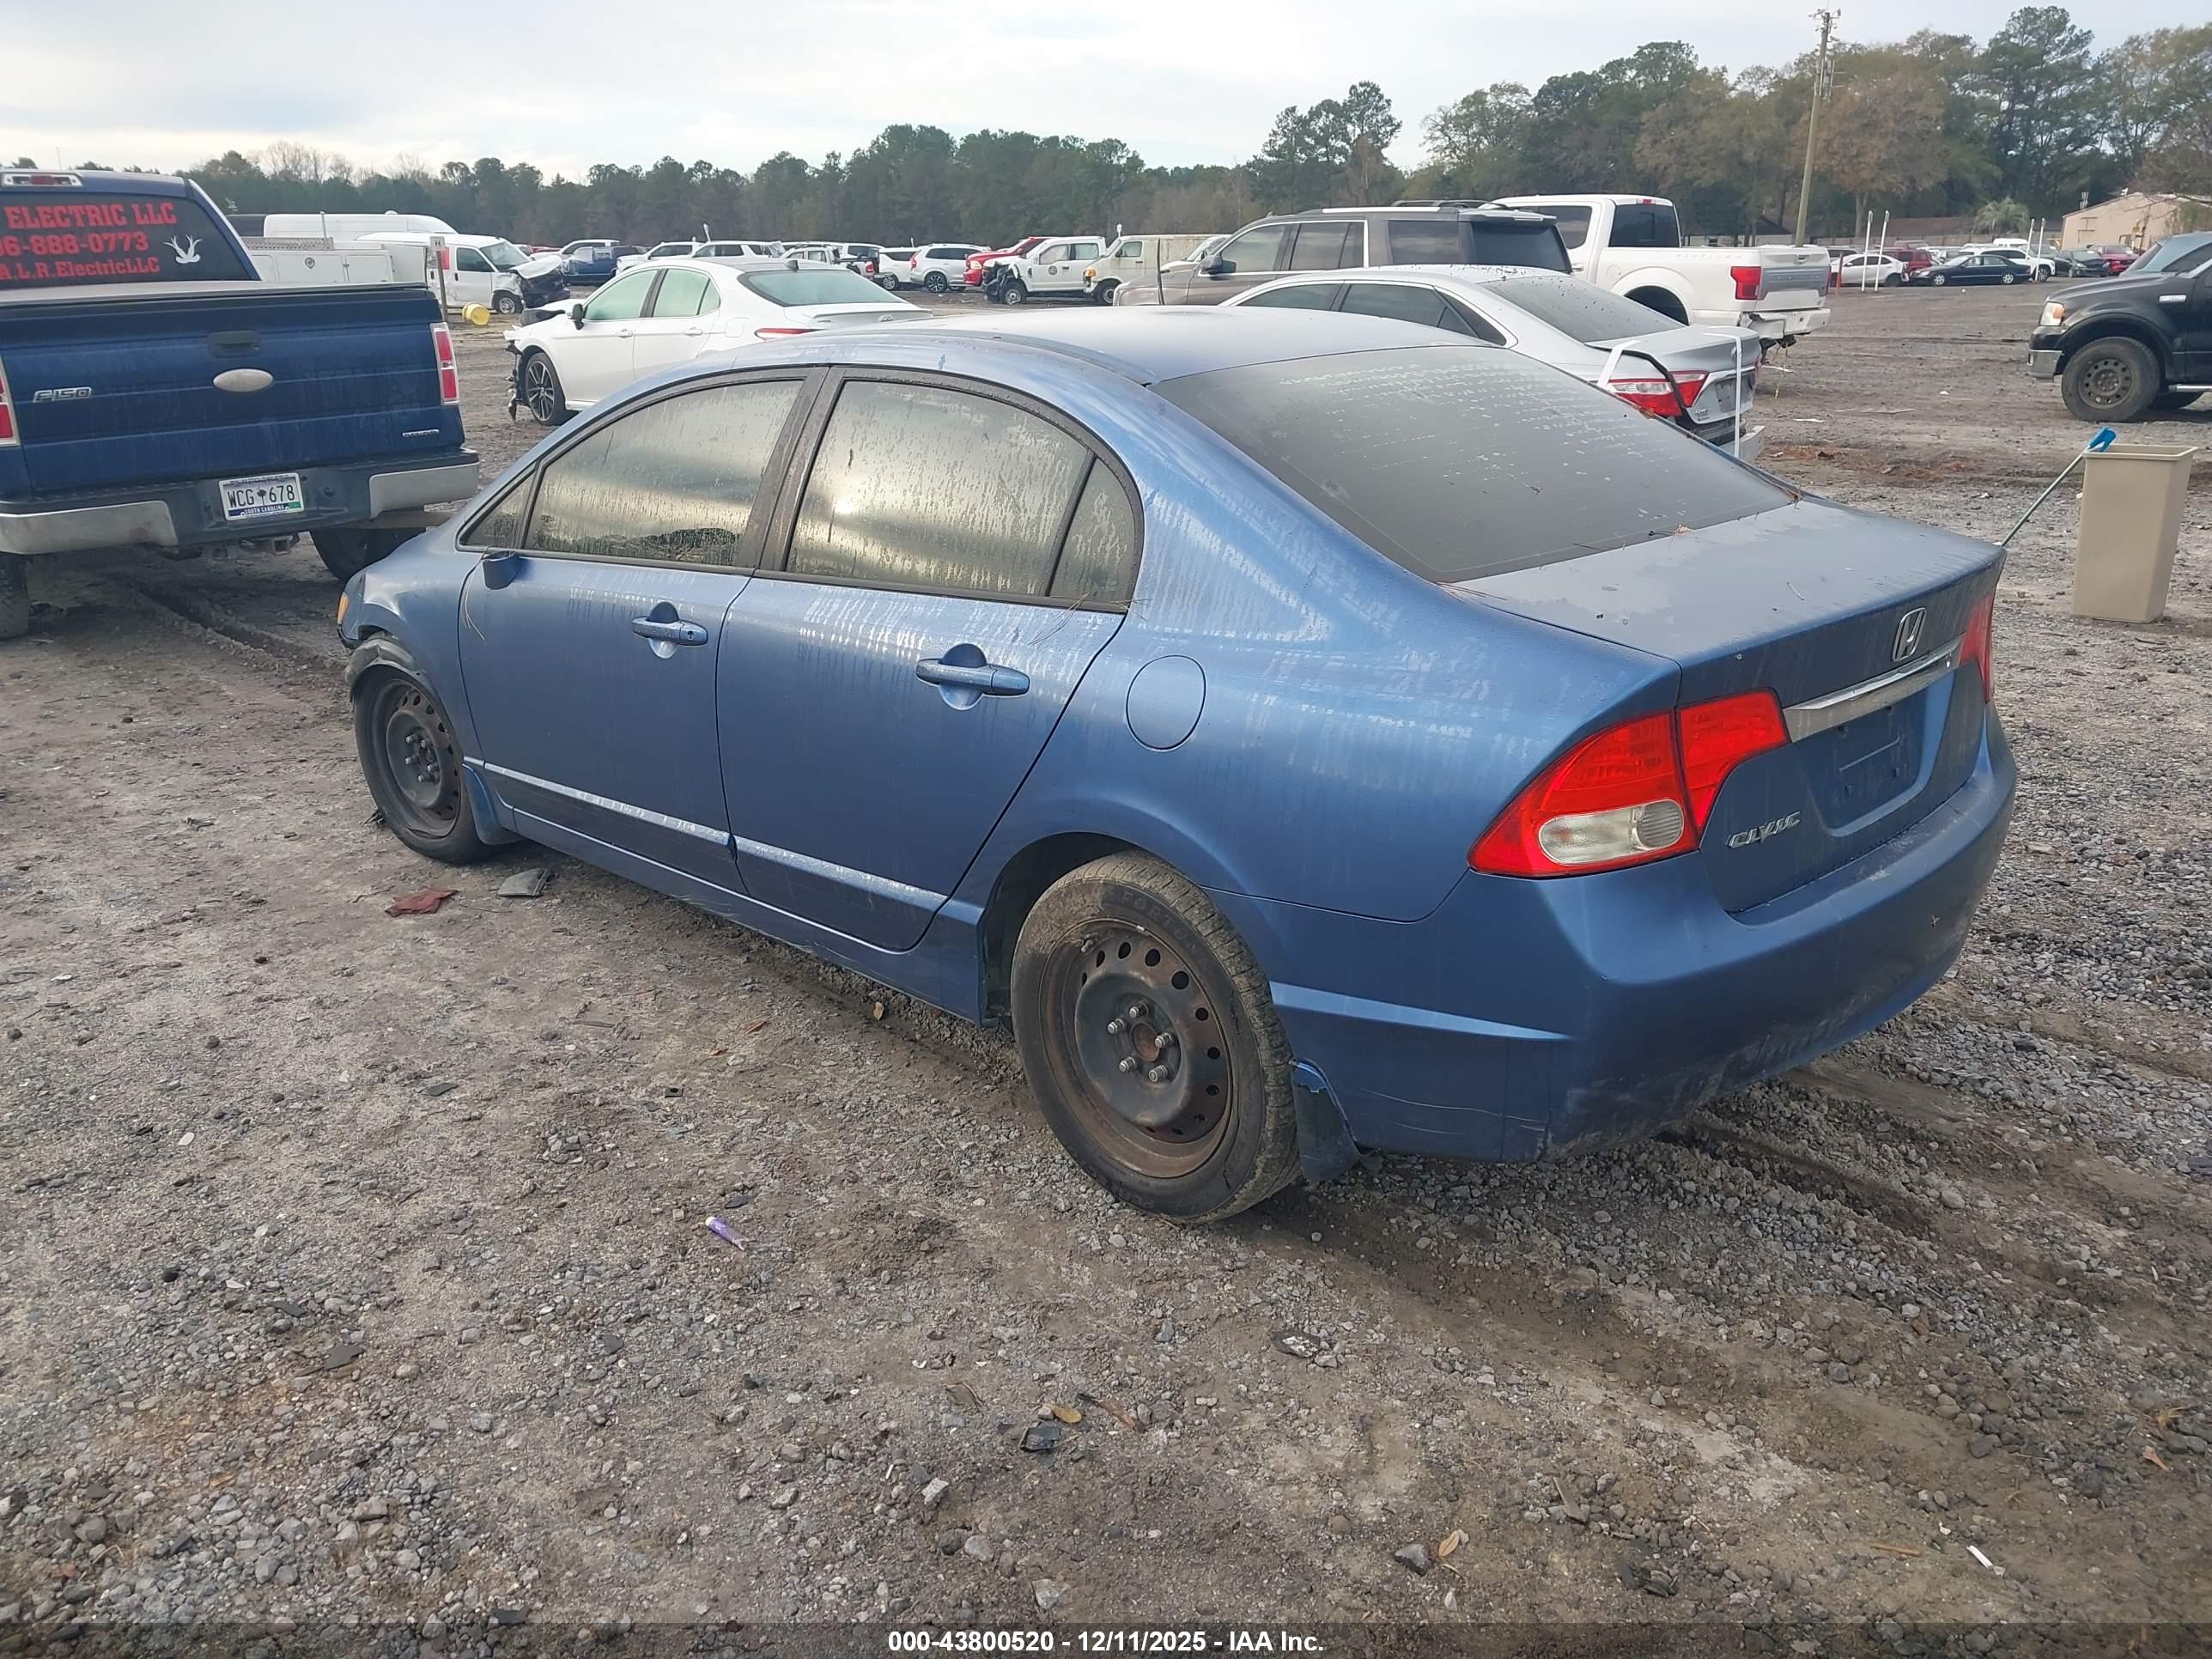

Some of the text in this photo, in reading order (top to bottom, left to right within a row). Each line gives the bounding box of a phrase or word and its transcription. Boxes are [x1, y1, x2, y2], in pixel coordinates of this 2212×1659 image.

[4, 202, 178, 229] ELECTRIC LLC
[227, 484, 295, 508] WCG 678
[261, 504, 285, 513] CAROLINA
[1726, 811, 1801, 849] CIVIC
